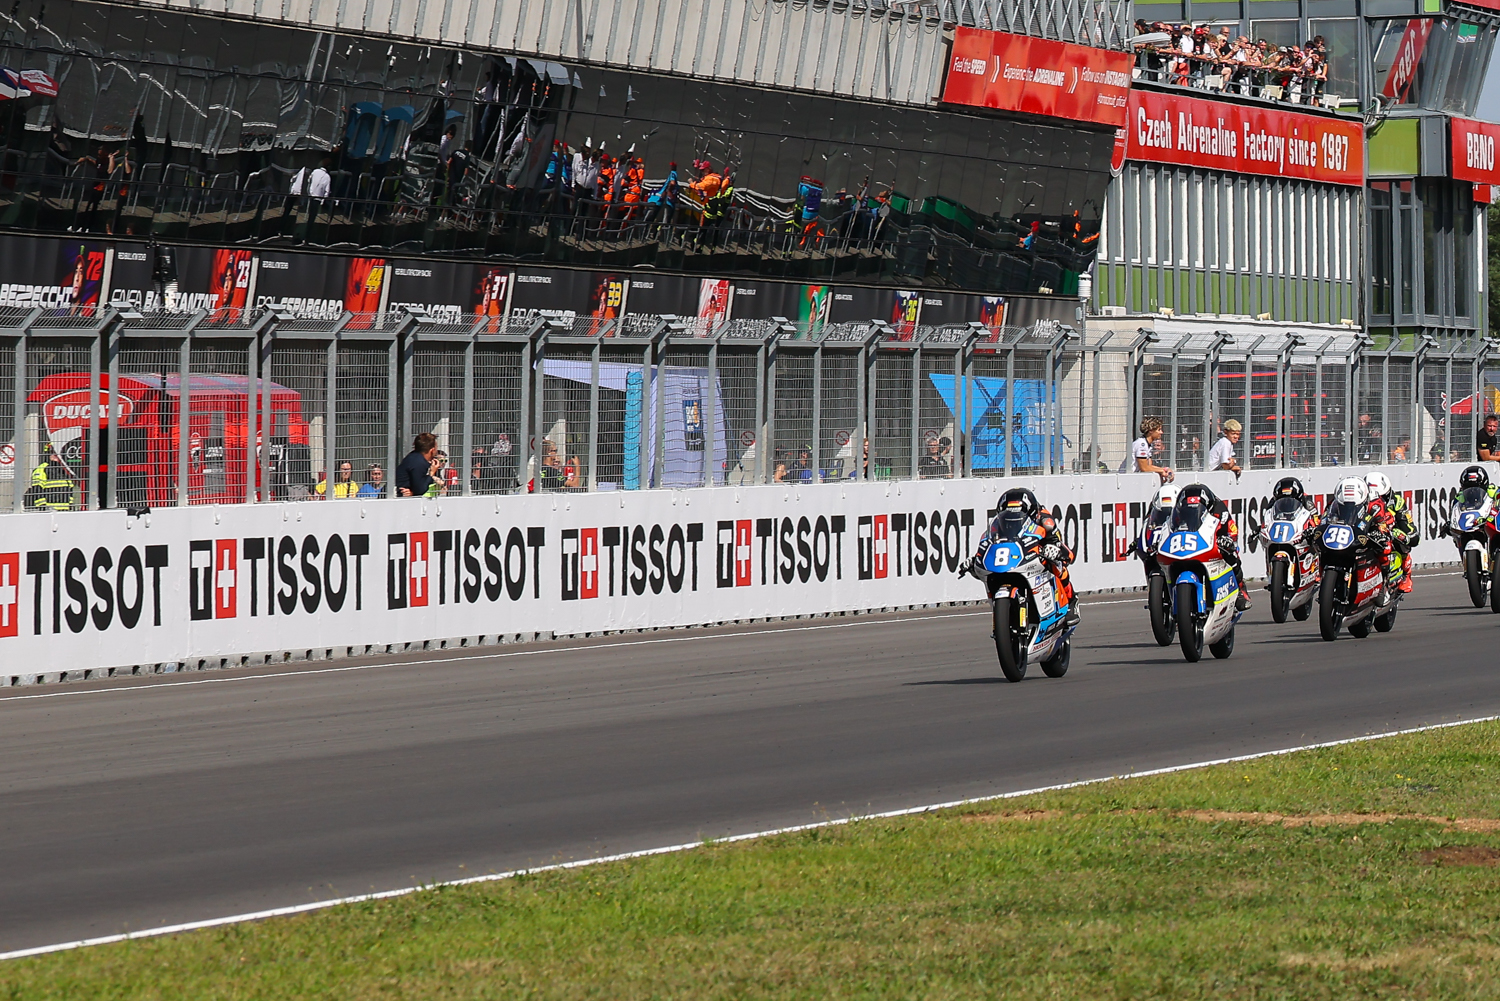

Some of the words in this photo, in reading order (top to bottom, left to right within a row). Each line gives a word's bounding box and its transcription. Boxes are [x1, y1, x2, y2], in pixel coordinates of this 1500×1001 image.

[970, 58, 987, 75] SPEED
[1003, 63, 1026, 83] Experienc
[1137, 107, 1172, 149] Czech
[1178, 111, 1237, 158] Adrenaline
[1244, 122, 1285, 173] Factory
[1288, 129, 1317, 167] since
[1321, 132, 1349, 172] 1987
[1466, 132, 1495, 172] BRNO
[86, 252, 105, 281] 72
[236, 261, 250, 288] 23
[491, 276, 508, 301] 37
[607, 281, 622, 307] 33
[53, 404, 124, 420] DUCAI
[1273, 524, 1289, 542] 11
[1464, 513, 1475, 527] 2
[891, 508, 975, 577] TISSOT
[1326, 527, 1351, 545] 38
[602, 523, 704, 597] TISSOT
[756, 514, 847, 586] TISSOT
[994, 547, 1010, 566] 8
[243, 533, 370, 617] TISSOT
[433, 526, 545, 605] TISSOT
[26, 544, 169, 635] TISSOT
